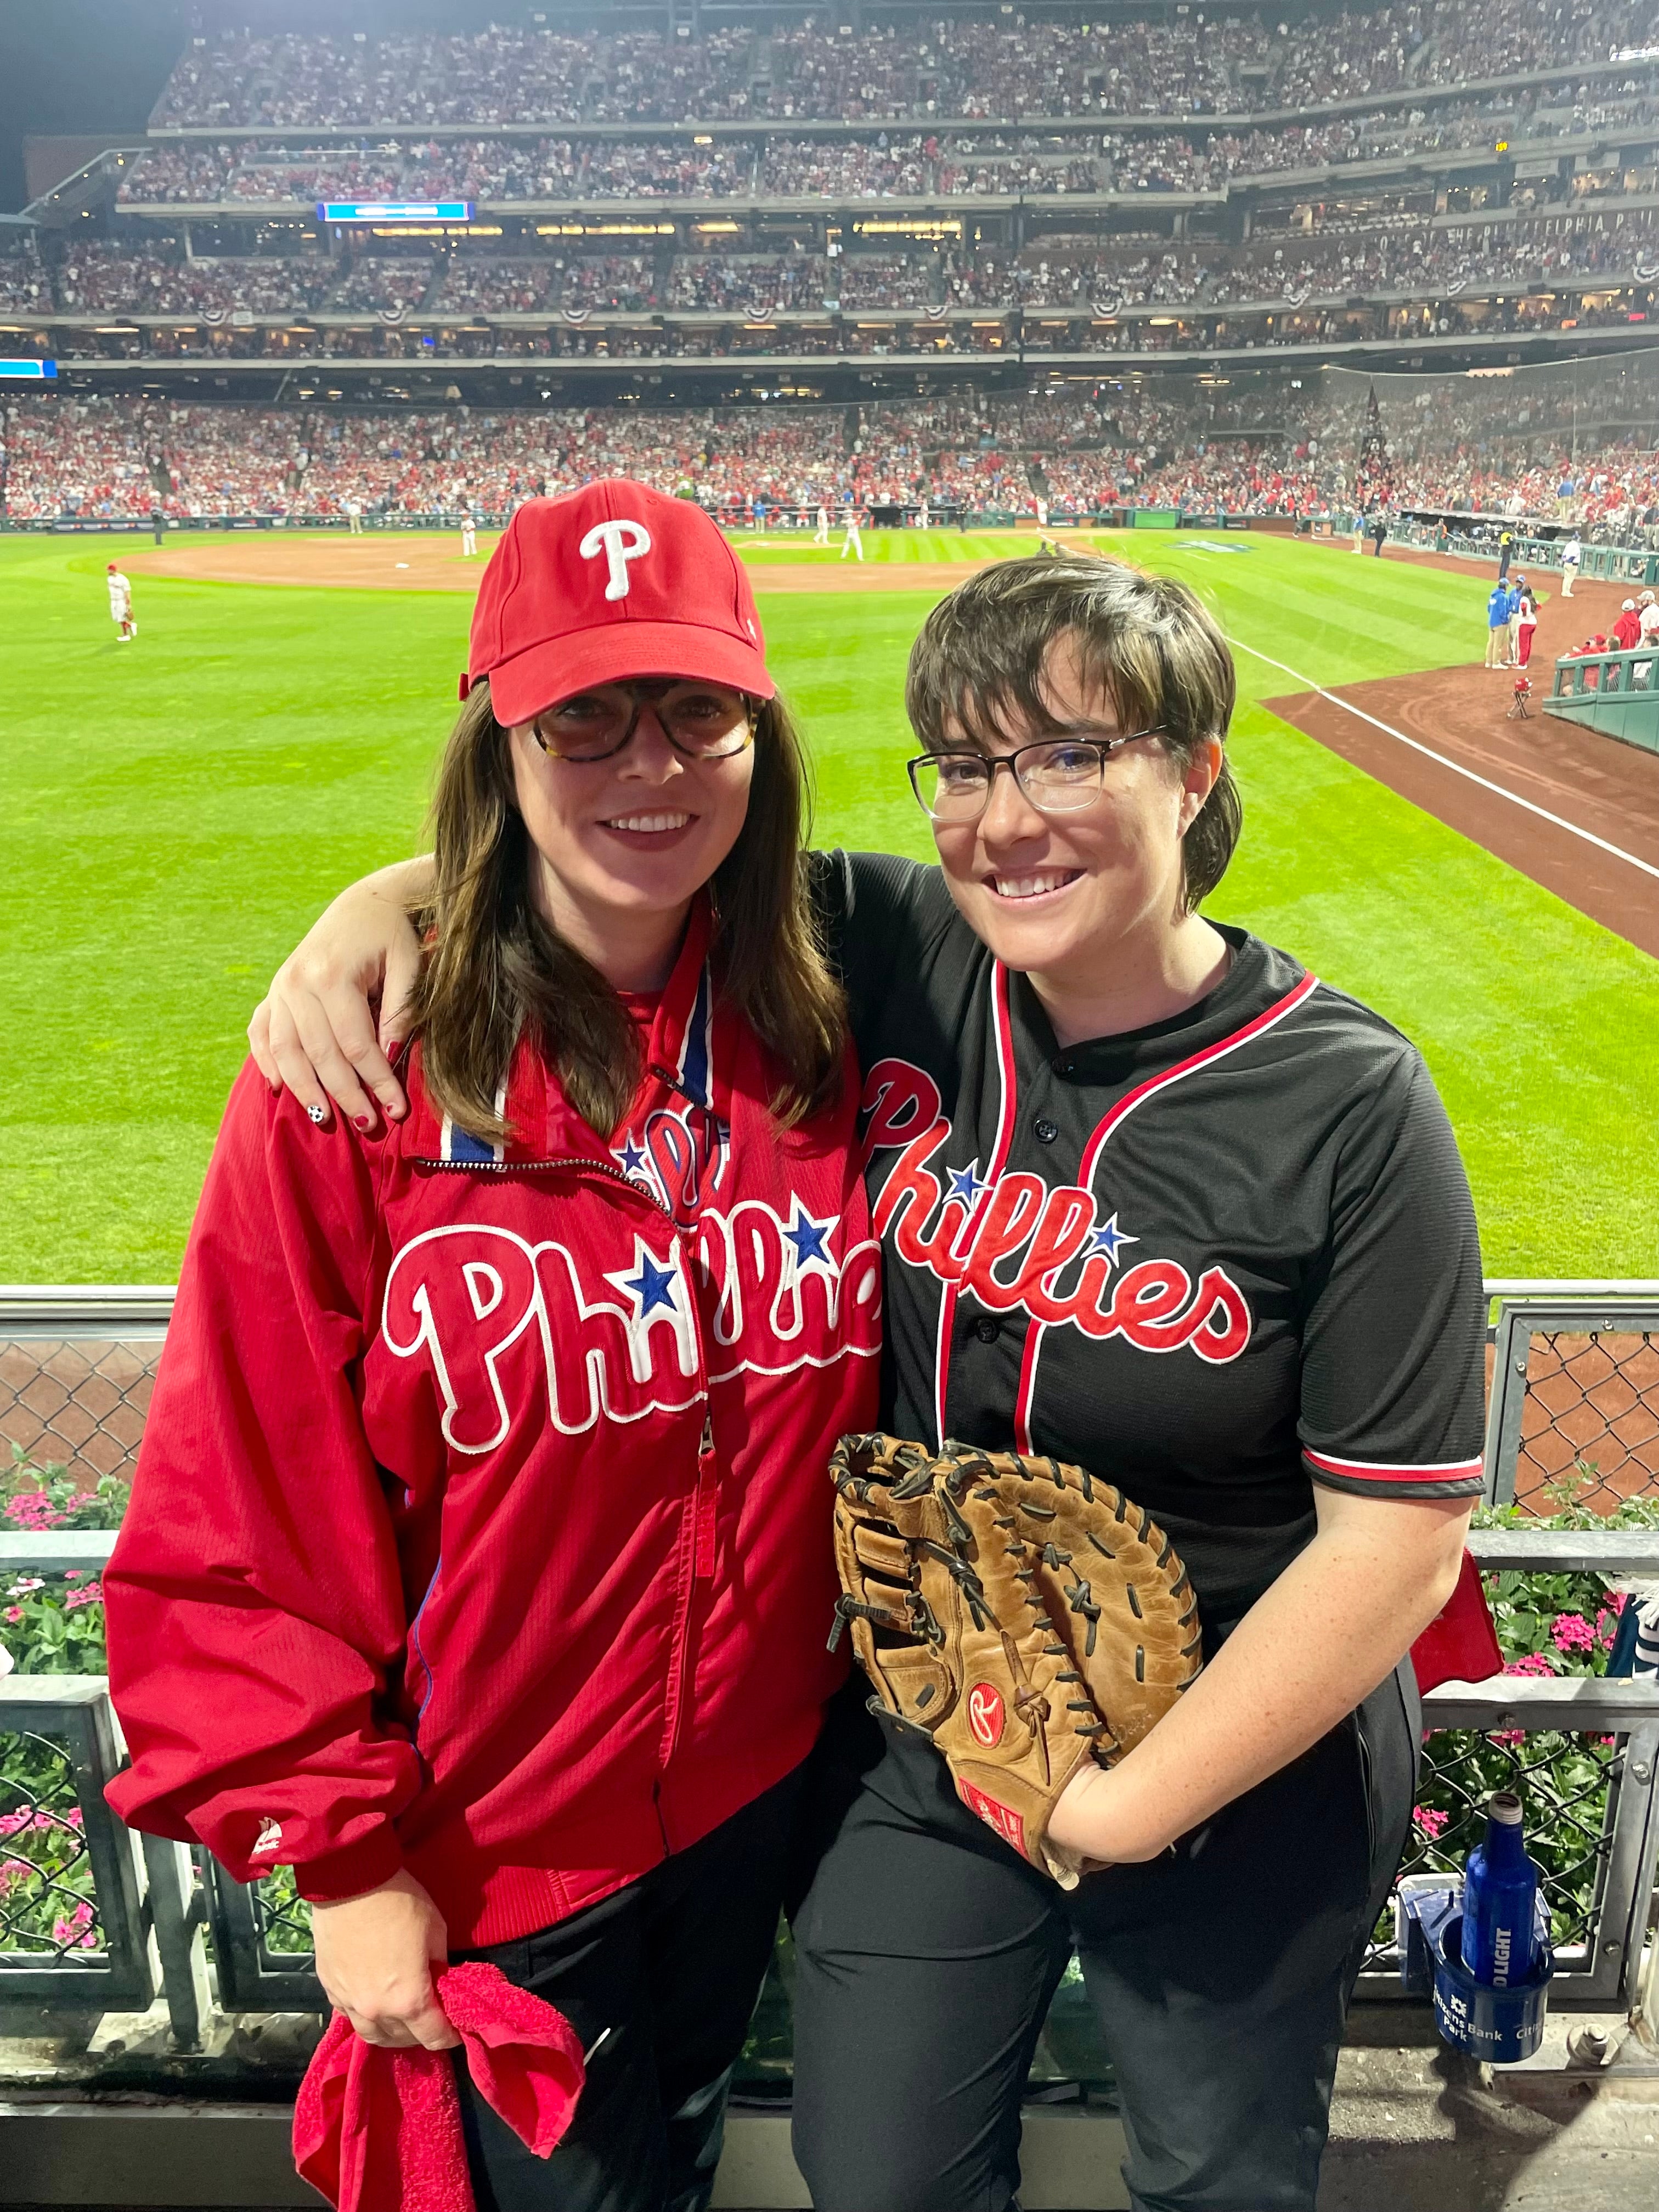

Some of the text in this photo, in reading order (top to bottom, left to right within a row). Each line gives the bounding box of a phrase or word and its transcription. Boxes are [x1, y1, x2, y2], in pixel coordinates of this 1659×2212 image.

[579, 519, 651, 602] P
[862, 1058, 1252, 1365] Phillies
[382, 1189, 882, 1455] Phillie
[970, 1690, 998, 1743] R
[1493, 1928, 1511, 1973] LIGHT
[1443, 2015, 1467, 2042] Park
[1468, 2023, 1503, 2041] Bank
